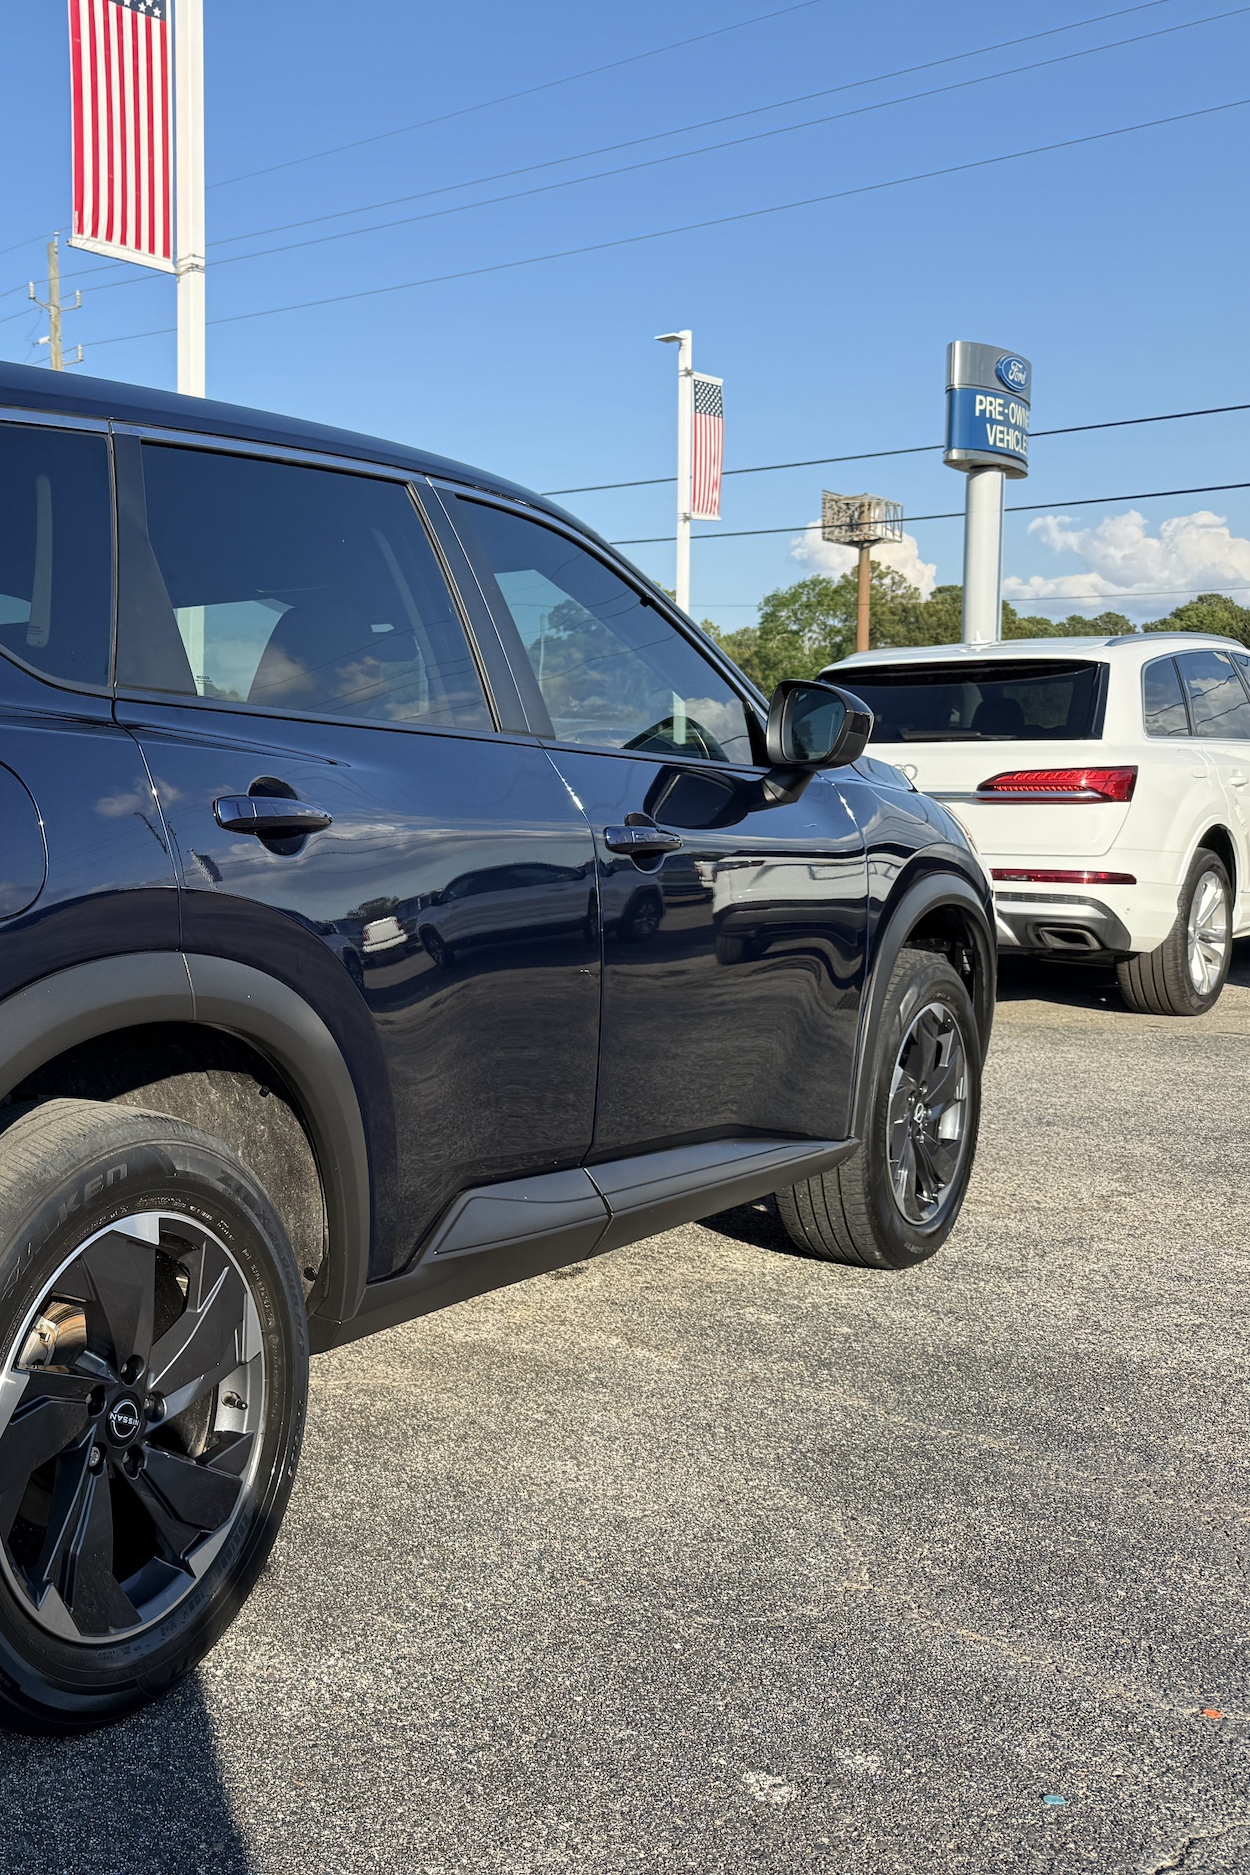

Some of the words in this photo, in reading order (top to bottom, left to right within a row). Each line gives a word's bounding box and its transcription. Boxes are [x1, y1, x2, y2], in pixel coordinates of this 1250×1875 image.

[1008, 361, 1027, 385] Ford
[975, 394, 1029, 430] PRE-OWNE
[985, 423, 1028, 456] VEHICLE
[109, 1412, 139, 1426] NISSAN
